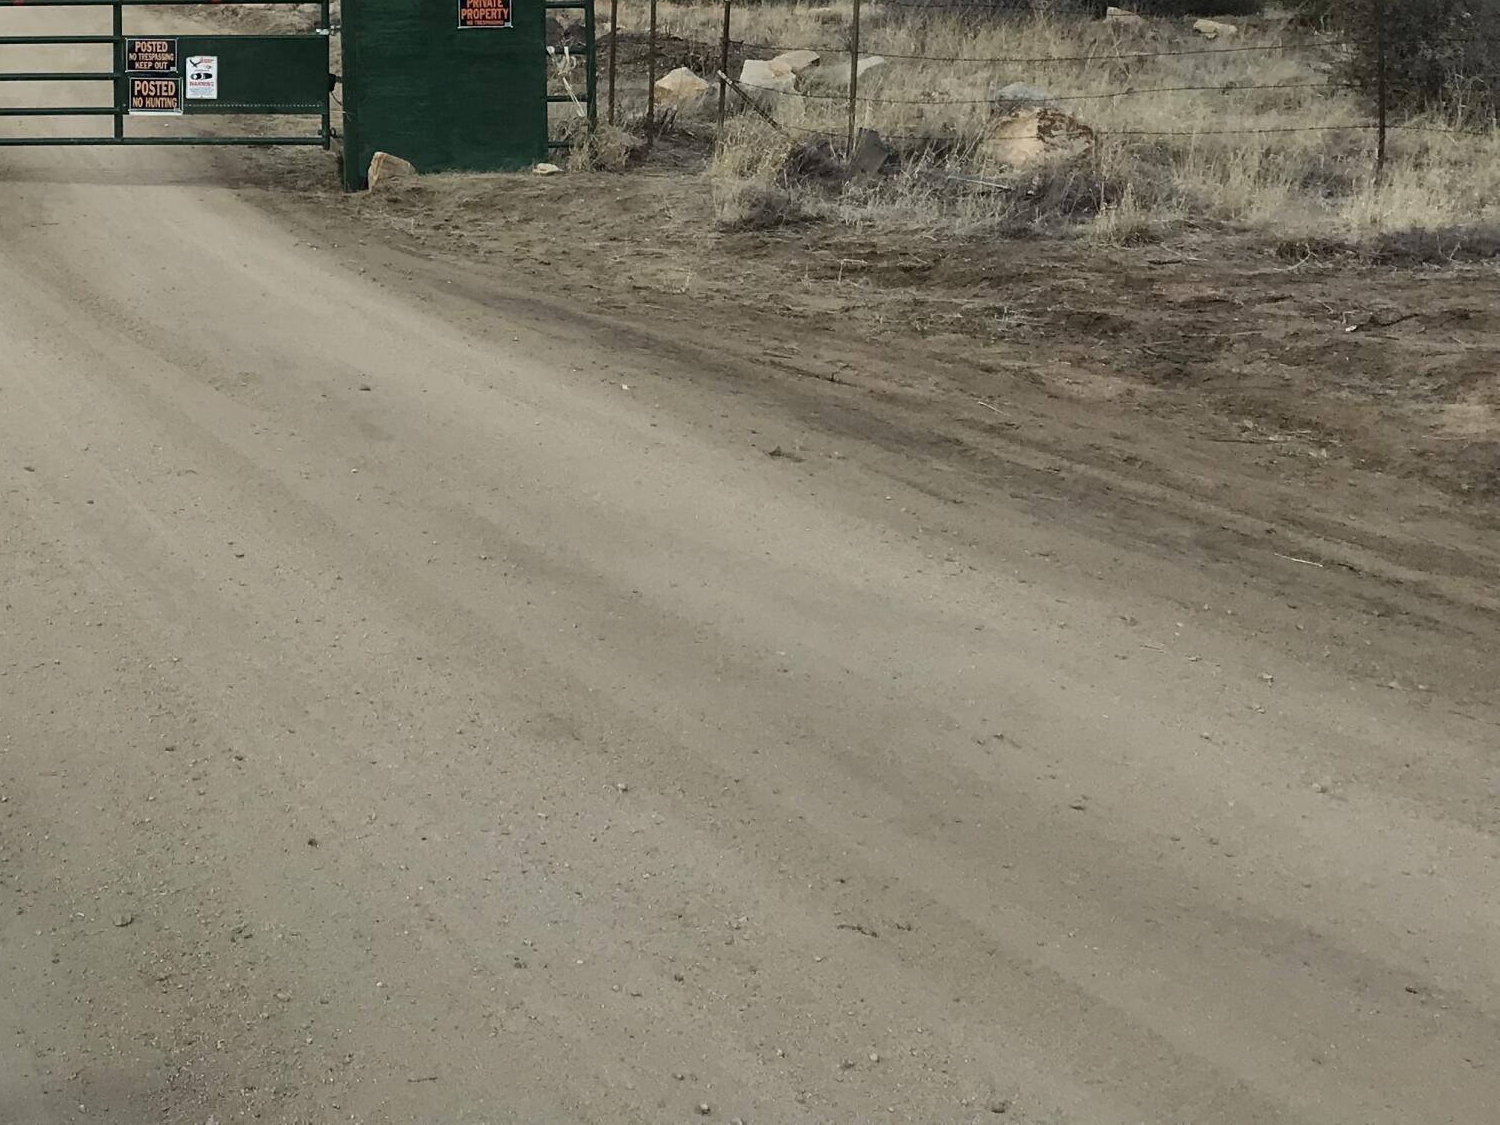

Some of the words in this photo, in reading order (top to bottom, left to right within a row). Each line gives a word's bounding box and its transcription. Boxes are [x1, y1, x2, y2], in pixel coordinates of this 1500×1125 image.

[461, 8, 509, 19] PROPERTY
[135, 42, 167, 52] POSTED
[139, 53, 174, 61] TRESPASSING
[135, 81, 175, 95] POSTED
[133, 97, 143, 108] NO
[146, 97, 177, 107] HUNTING
